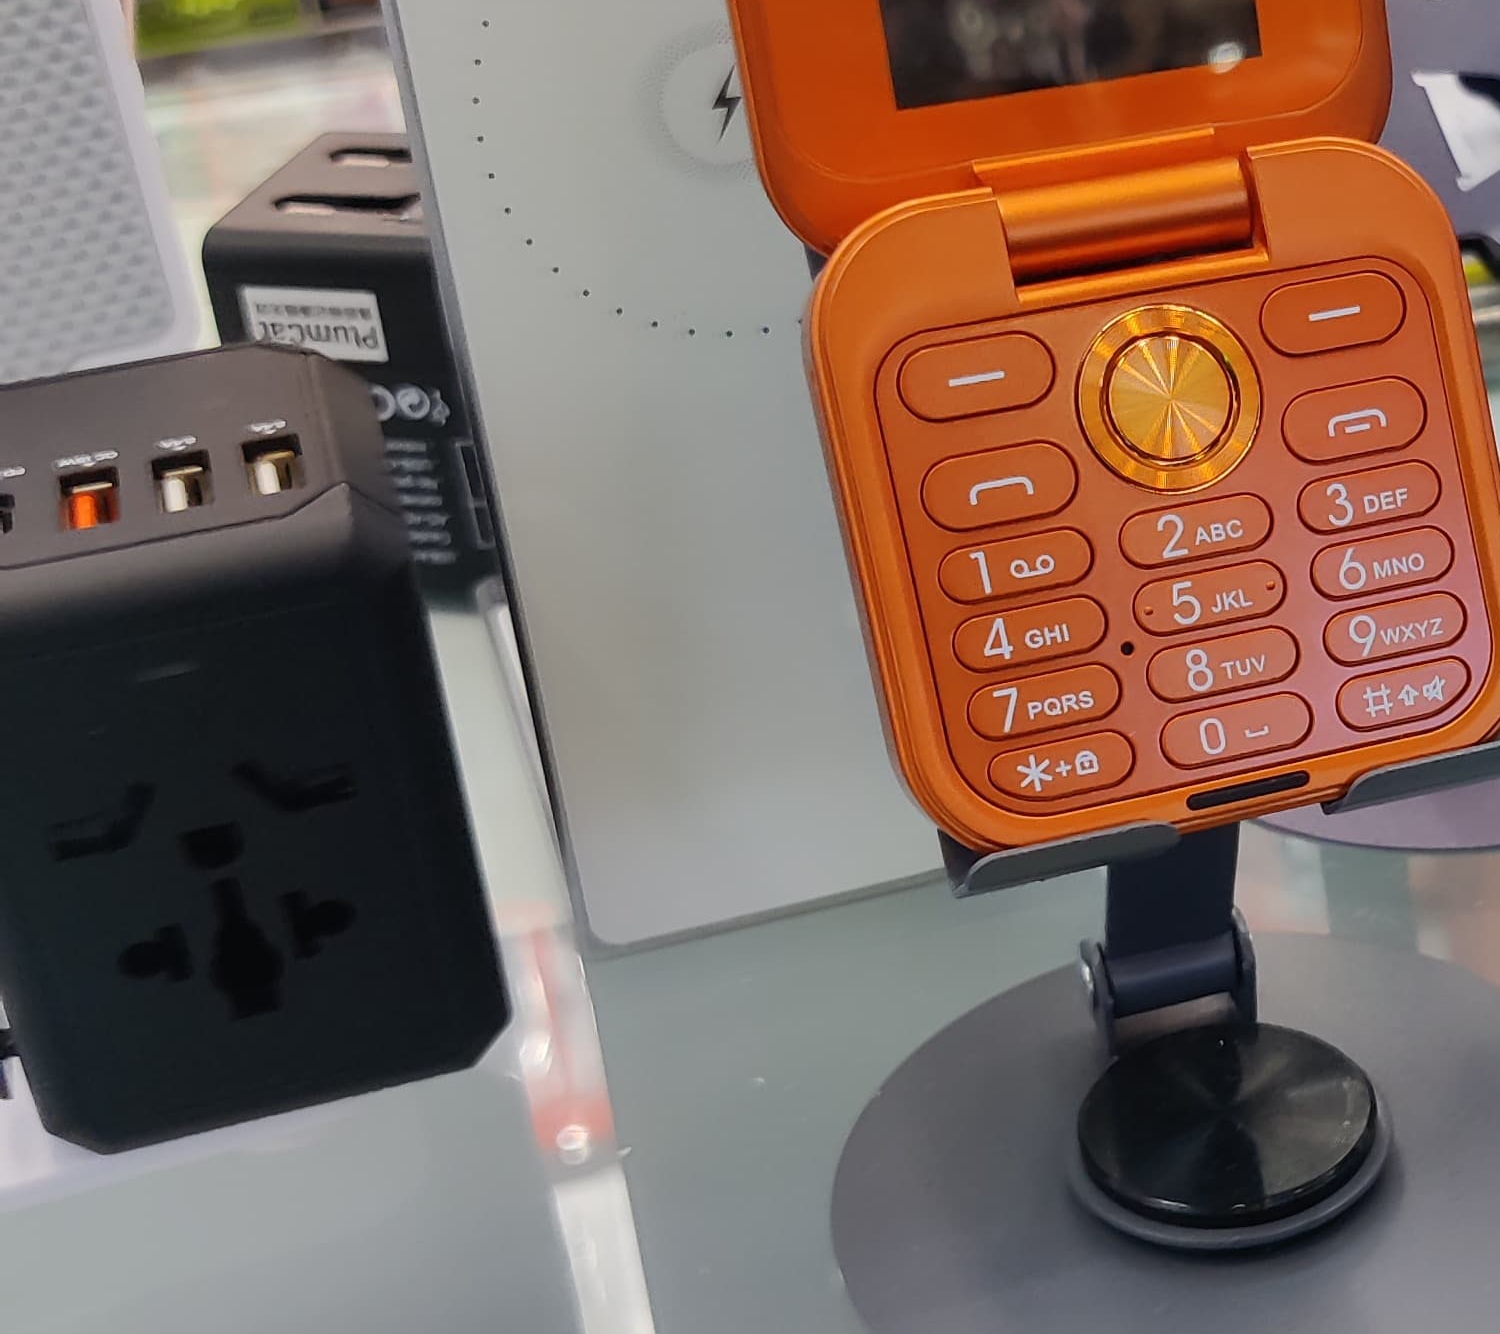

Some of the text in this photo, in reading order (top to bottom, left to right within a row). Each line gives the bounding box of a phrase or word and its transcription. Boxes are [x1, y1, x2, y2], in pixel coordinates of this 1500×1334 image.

[1326, 482, 1409, 527] 3 DEF
[1157, 514, 1245, 559] 2 ABC
[969, 551, 992, 595] 1
[1338, 547, 1425, 591] 6 MNO
[1172, 581, 1253, 626] 5 JKL
[983, 618, 1071, 660] 4 GHI
[1349, 614, 1444, 657] 9 WXYZ
[1185, 649, 1267, 693] 8 TUV
[992, 686, 1095, 733] 7 PQRS
[1362, 682, 1393, 718] #
[1199, 717, 1227, 755] 0
